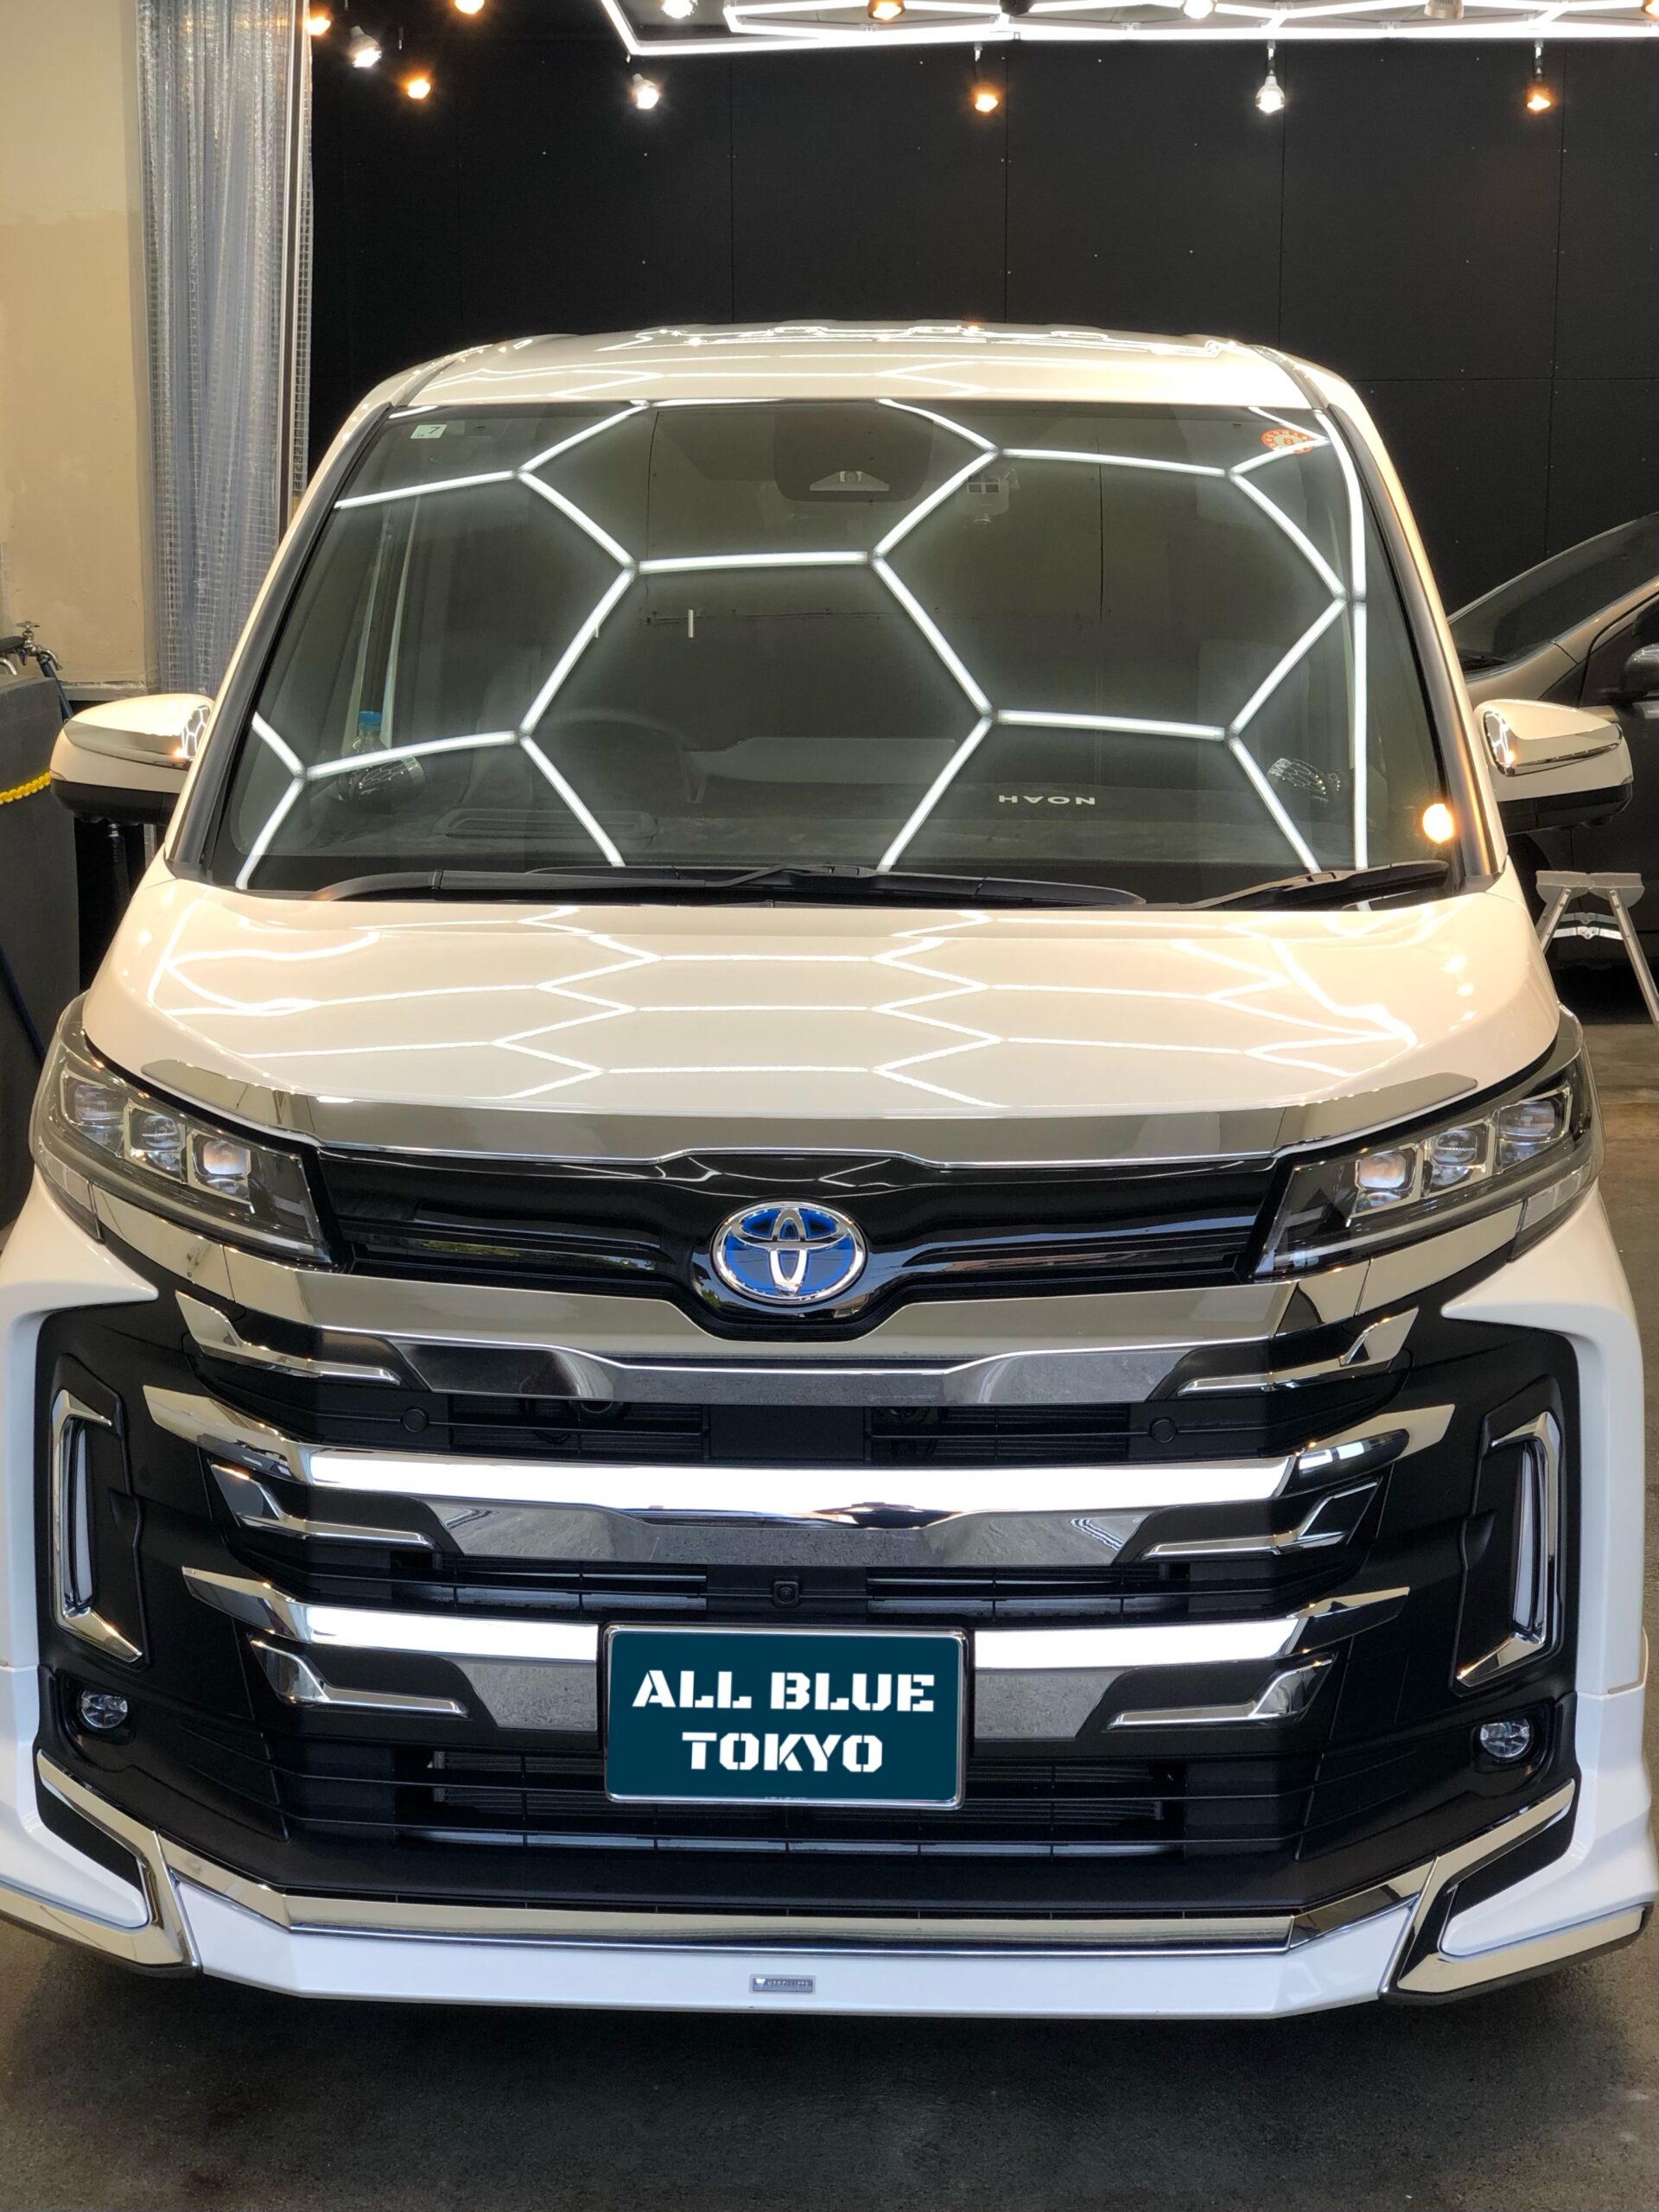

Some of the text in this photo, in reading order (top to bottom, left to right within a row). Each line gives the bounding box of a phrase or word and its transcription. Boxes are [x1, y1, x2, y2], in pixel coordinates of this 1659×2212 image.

[998, 795, 1096, 805] NOAH
[632, 1669, 935, 1713] ALL BLUE
[682, 1732, 883, 1773] TOKYO
